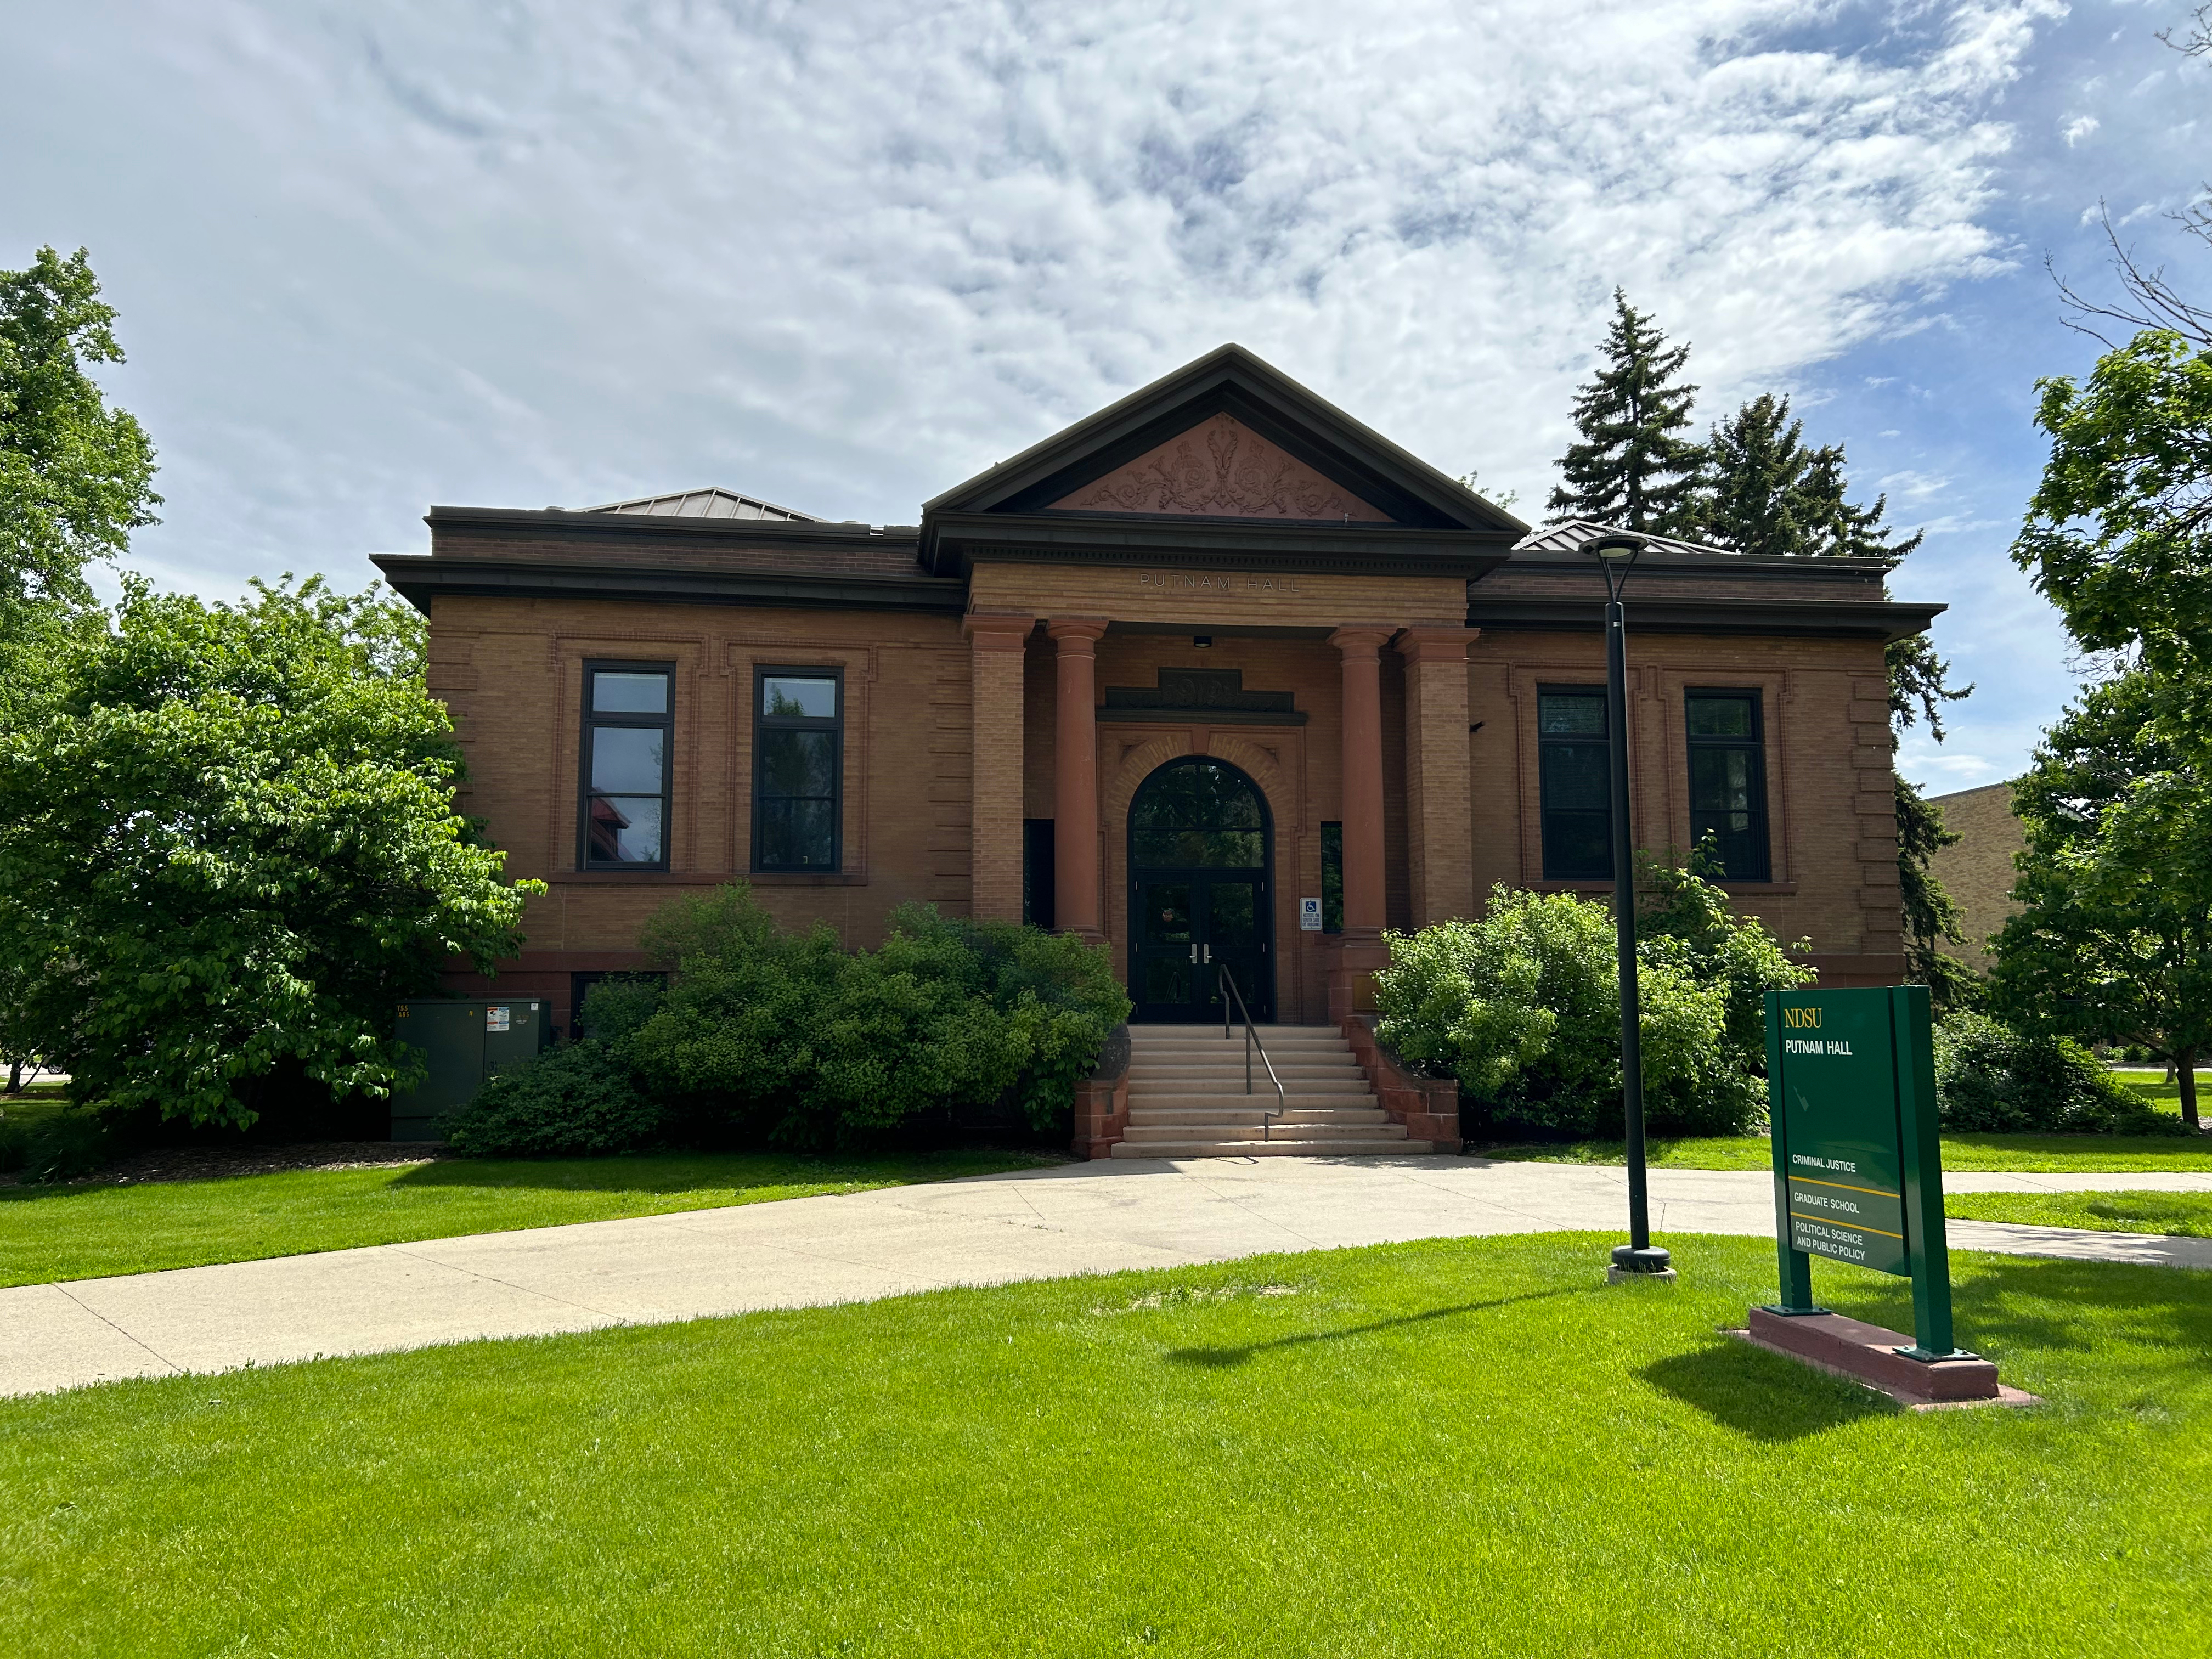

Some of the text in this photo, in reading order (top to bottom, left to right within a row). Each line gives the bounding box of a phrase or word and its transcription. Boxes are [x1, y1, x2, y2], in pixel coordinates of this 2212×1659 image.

[1141, 573, 1300, 591] PUTNAM HALL
[1784, 1008, 1822, 1028] NDSU
[1785, 1040, 1853, 1056] PUTNAM HALL
[1792, 1154, 1856, 1172] CRIMINAL JUSTICE
[1794, 1192, 1860, 1214] GRADUATE SCHOOL
[1796, 1221, 1863, 1245] POLITICAL SCIENCE
[1797, 1235, 1865, 1261] AND PUBLIC POLICY
